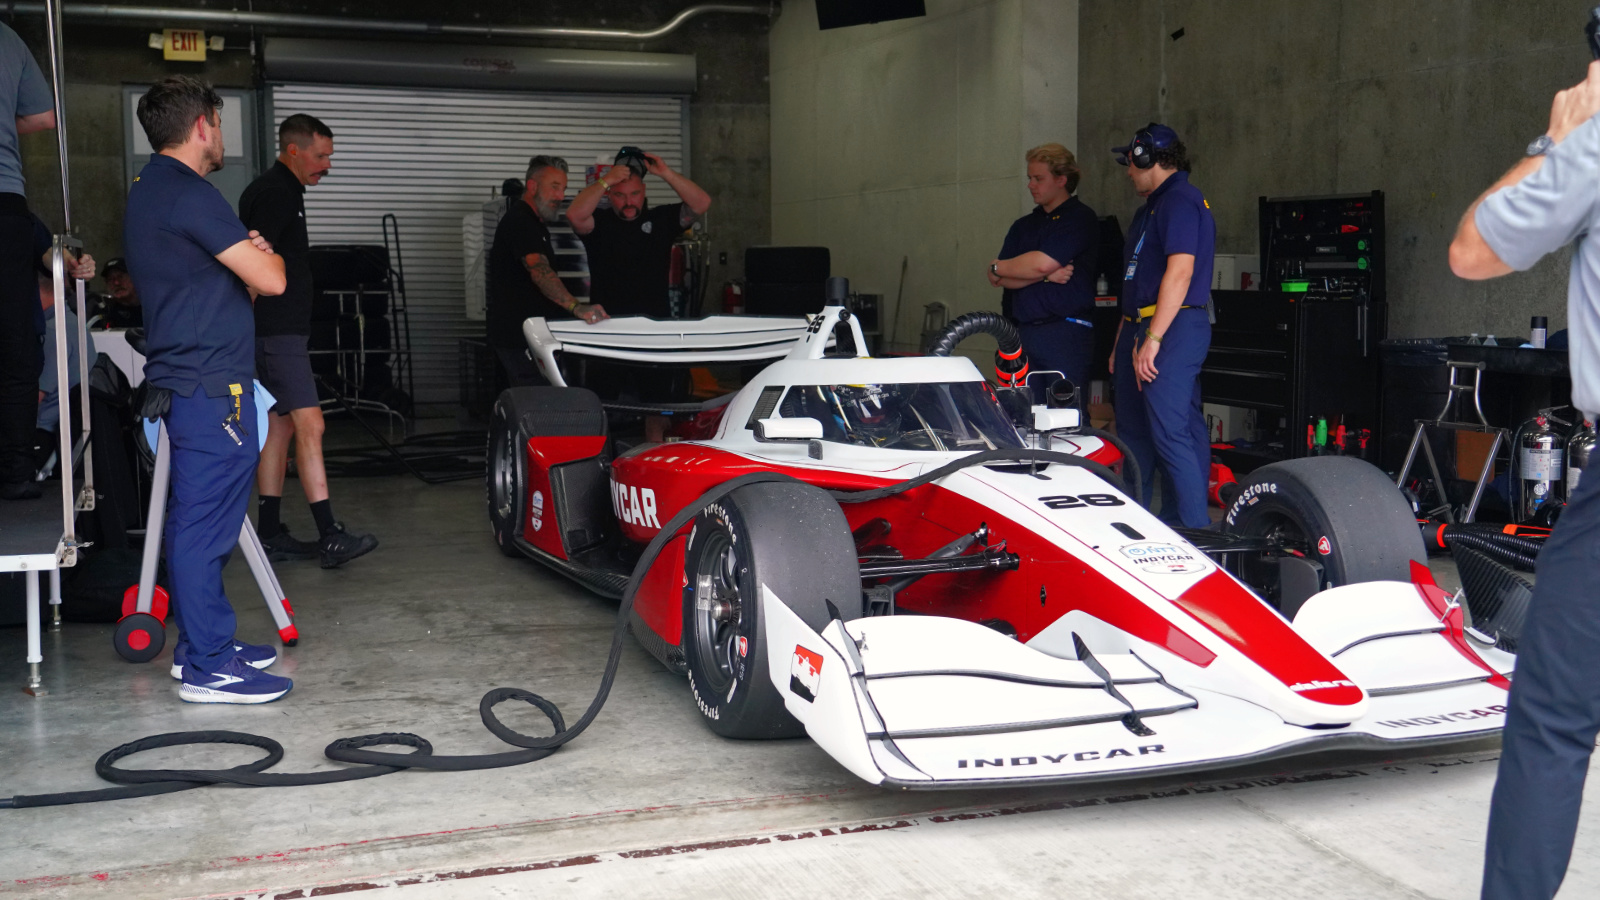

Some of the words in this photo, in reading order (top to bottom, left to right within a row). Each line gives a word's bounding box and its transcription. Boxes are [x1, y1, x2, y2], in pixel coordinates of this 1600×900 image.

[172, 31, 199, 51] EXIT
[610, 478, 662, 529] YCAR
[1037, 493, 1126, 510] 28
[1226, 482, 1277, 526] Firestone
[704, 503, 737, 546] Firestone
[1133, 554, 1195, 565] INDYCAR
[1146, 546, 1177, 554] NTT
[687, 669, 720, 720] Firestone
[957, 744, 1167, 769] INDYCAR
